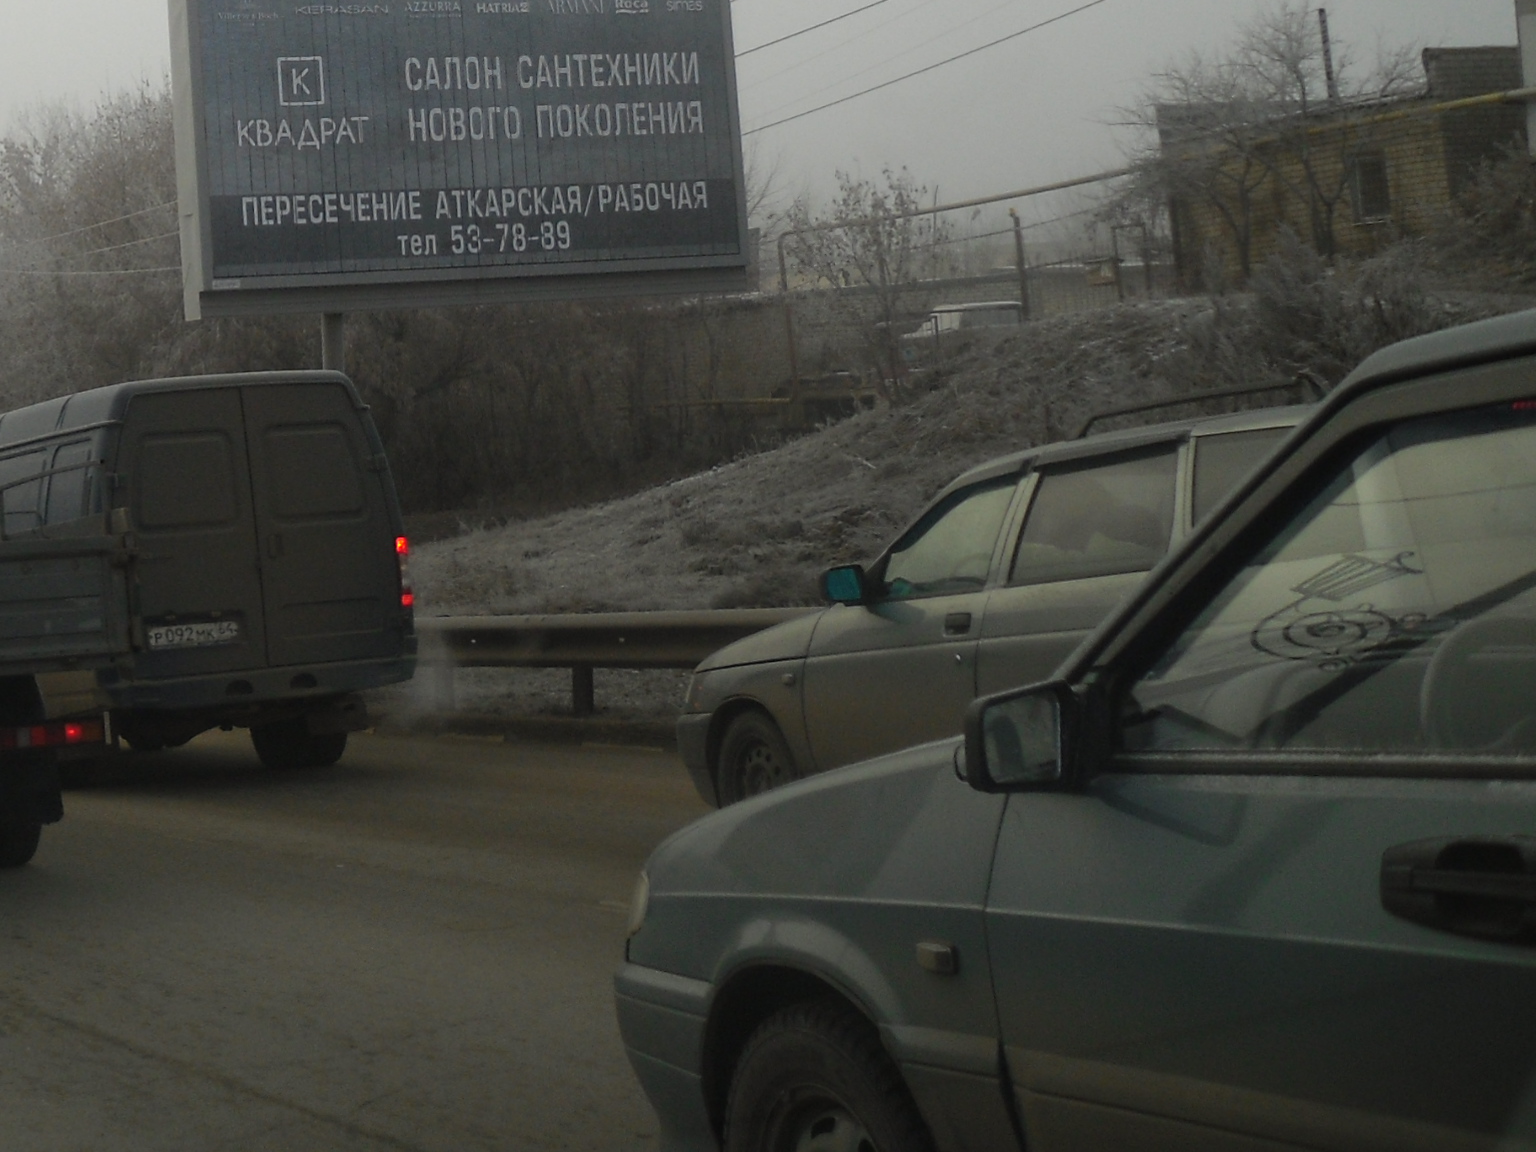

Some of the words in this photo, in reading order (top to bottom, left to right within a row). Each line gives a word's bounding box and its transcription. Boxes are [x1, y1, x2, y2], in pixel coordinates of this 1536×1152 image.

[295, 4, 389, 15] KERASAN
[404, 1, 461, 12] AZZURRA
[404, 55, 502, 91] САЛОН
[517, 51, 700, 89] САНТЕХНИКИ
[236, 116, 370, 151] КВАДРАТ
[408, 105, 521, 142] НОВОГО
[535, 100, 704, 138] ПОКОЛЕНИЯ
[241, 190, 422, 227] ПЕРЕСЕЧЕНИЕ
[435, 180, 709, 220] АТКАРСКАЯ/РАБОЧАЯ
[397, 233, 437, 256] тел
[449, 220, 572, 255] 53-78-89
